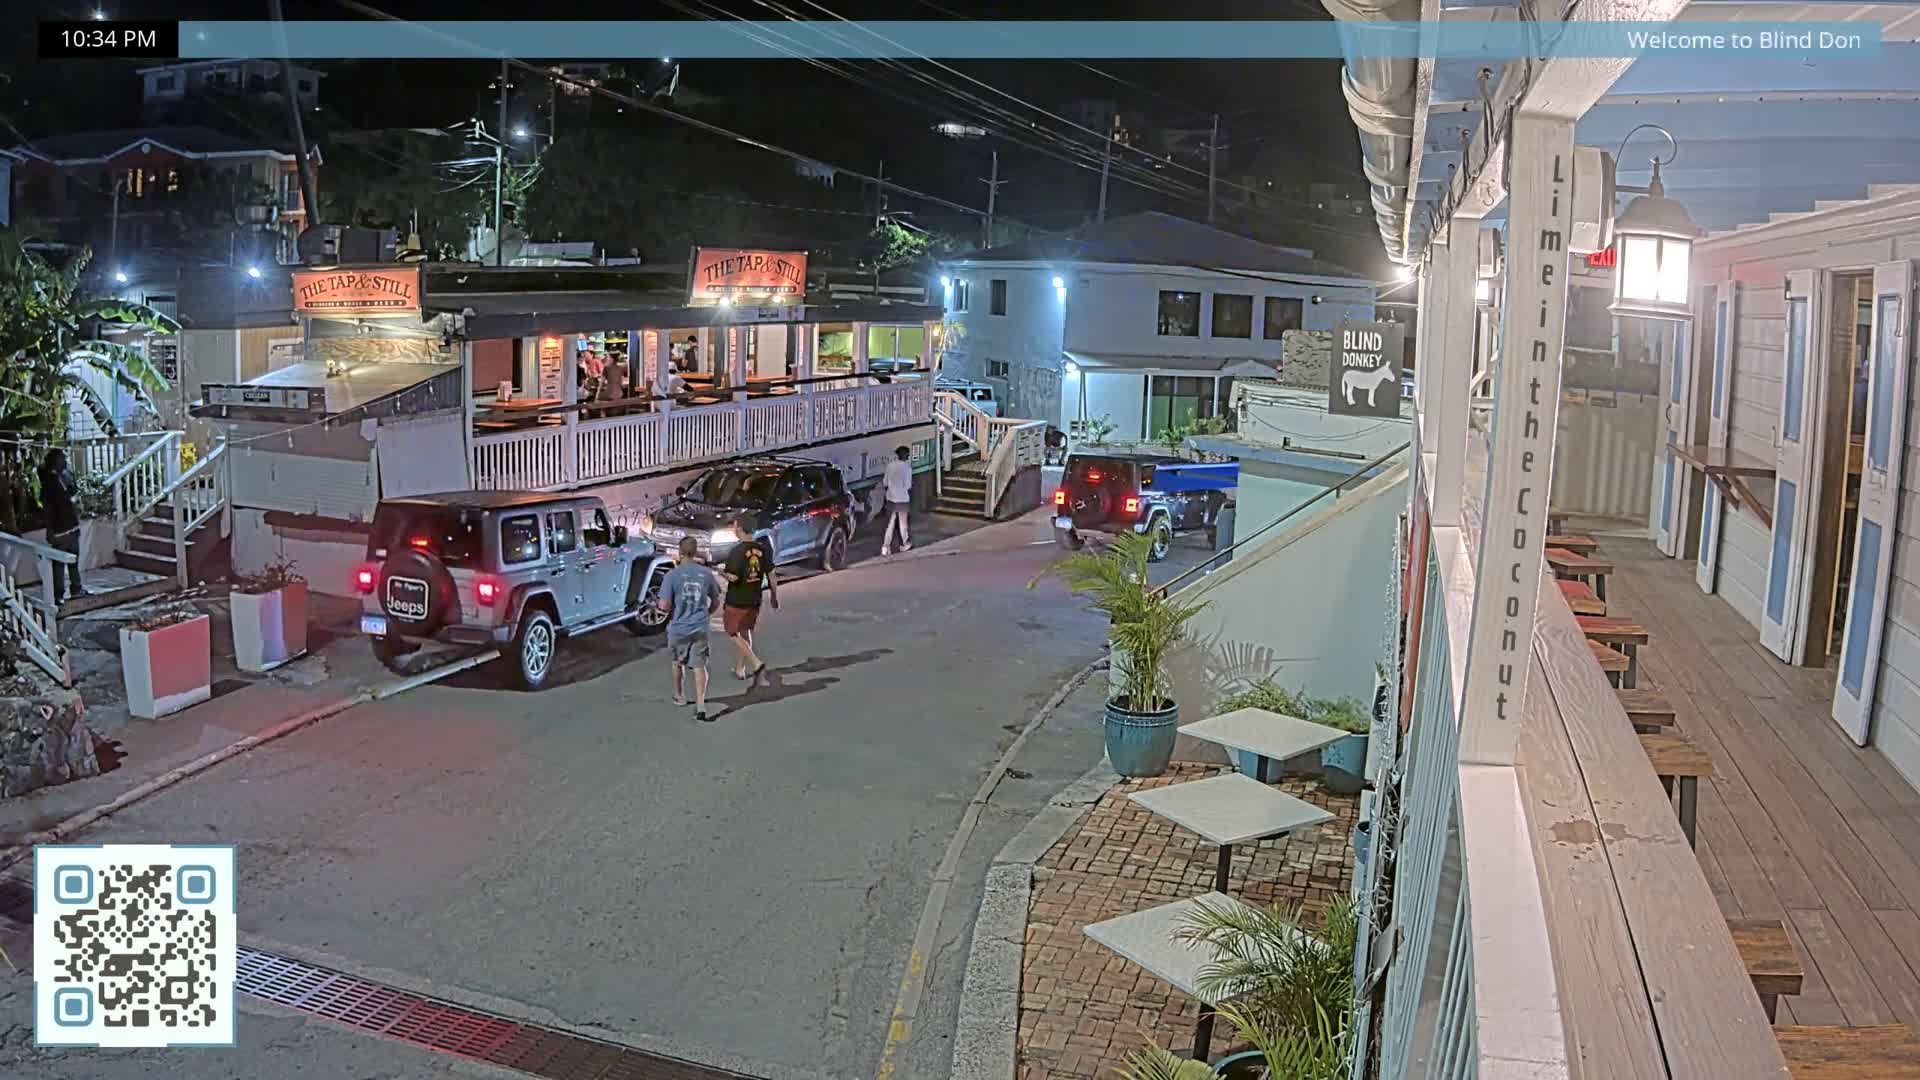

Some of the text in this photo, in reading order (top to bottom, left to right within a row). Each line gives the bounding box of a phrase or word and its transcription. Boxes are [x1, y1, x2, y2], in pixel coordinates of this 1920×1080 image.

[704, 259, 735, 283] THE
[737, 255, 762, 273] TAP
[775, 259, 801, 285] STILL
[300, 279, 328, 300] THE
[328, 275, 356, 290] TAP
[372, 276, 412, 299] STILL
[1343, 330, 1383, 351] BLIND
[1343, 352, 1383, 368] DONKEY
[387, 596, 424, 617] Jeeps
